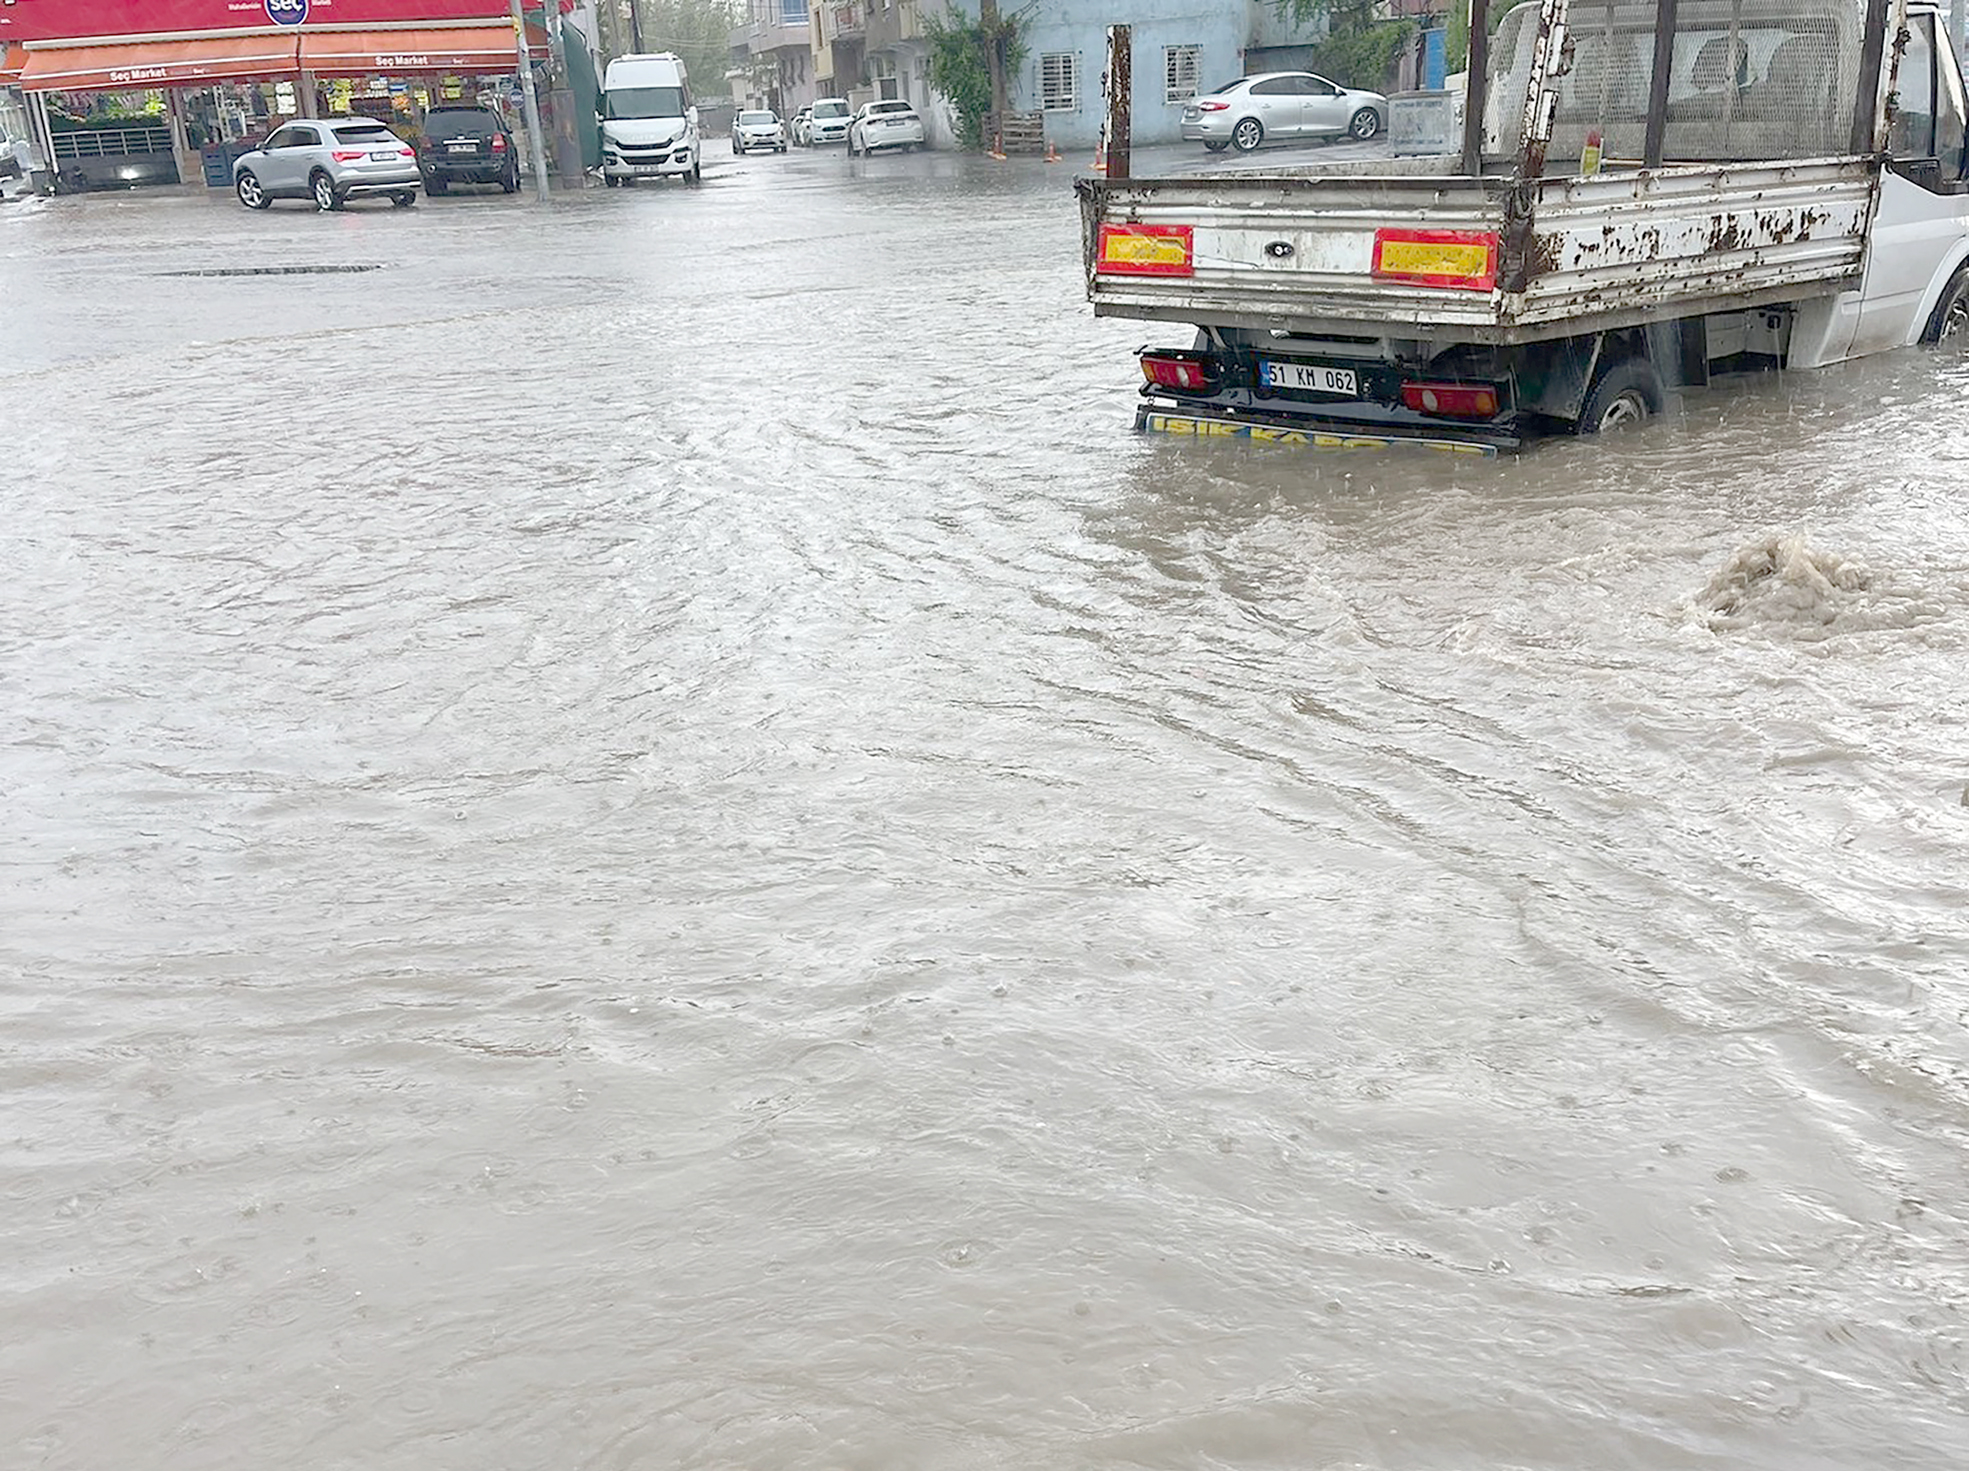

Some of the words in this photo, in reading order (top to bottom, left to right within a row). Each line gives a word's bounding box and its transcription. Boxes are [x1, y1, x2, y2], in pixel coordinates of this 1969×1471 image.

[395, 56, 428, 66] Market
[131, 68, 167, 79] Market
[1269, 365, 1286, 384] 51
[1296, 367, 1316, 387] KM
[1325, 370, 1354, 391] 062
